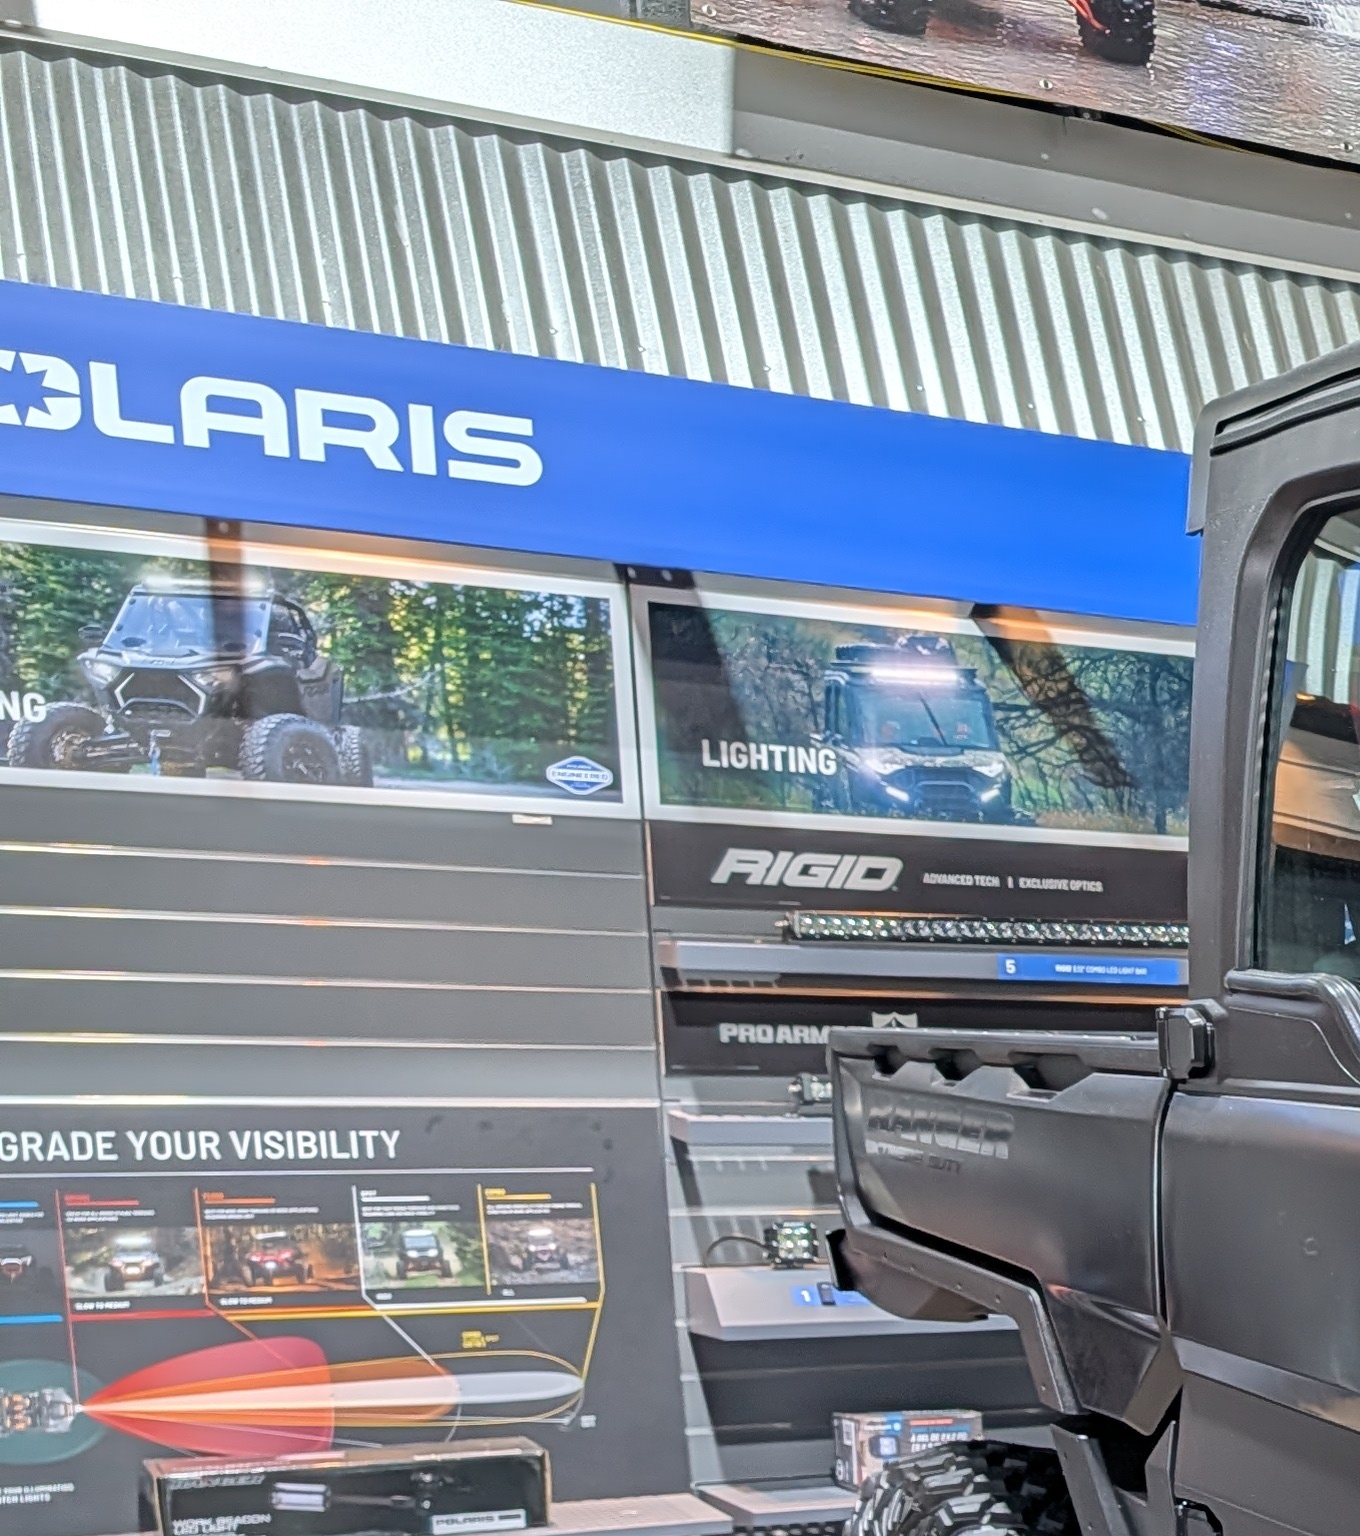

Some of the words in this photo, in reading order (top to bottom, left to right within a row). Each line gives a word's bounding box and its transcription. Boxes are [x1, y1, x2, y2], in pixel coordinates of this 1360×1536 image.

[702, 739, 837, 776] LIGHTING
[711, 848, 904, 891] RIGID
[923, 873, 973, 886] ADVANCED
[974, 875, 1000, 888] TECH
[1019, 877, 1069, 891] EXCLUSIVE
[1070, 879, 1103, 892] OPTICS
[1005, 960, 1016, 974] 5
[719, 1023, 773, 1043] PRO
[776, 1025, 848, 1044] ARM
[126, 1130, 221, 1162] YOUR
[228, 1129, 401, 1160] VISIBILITY
